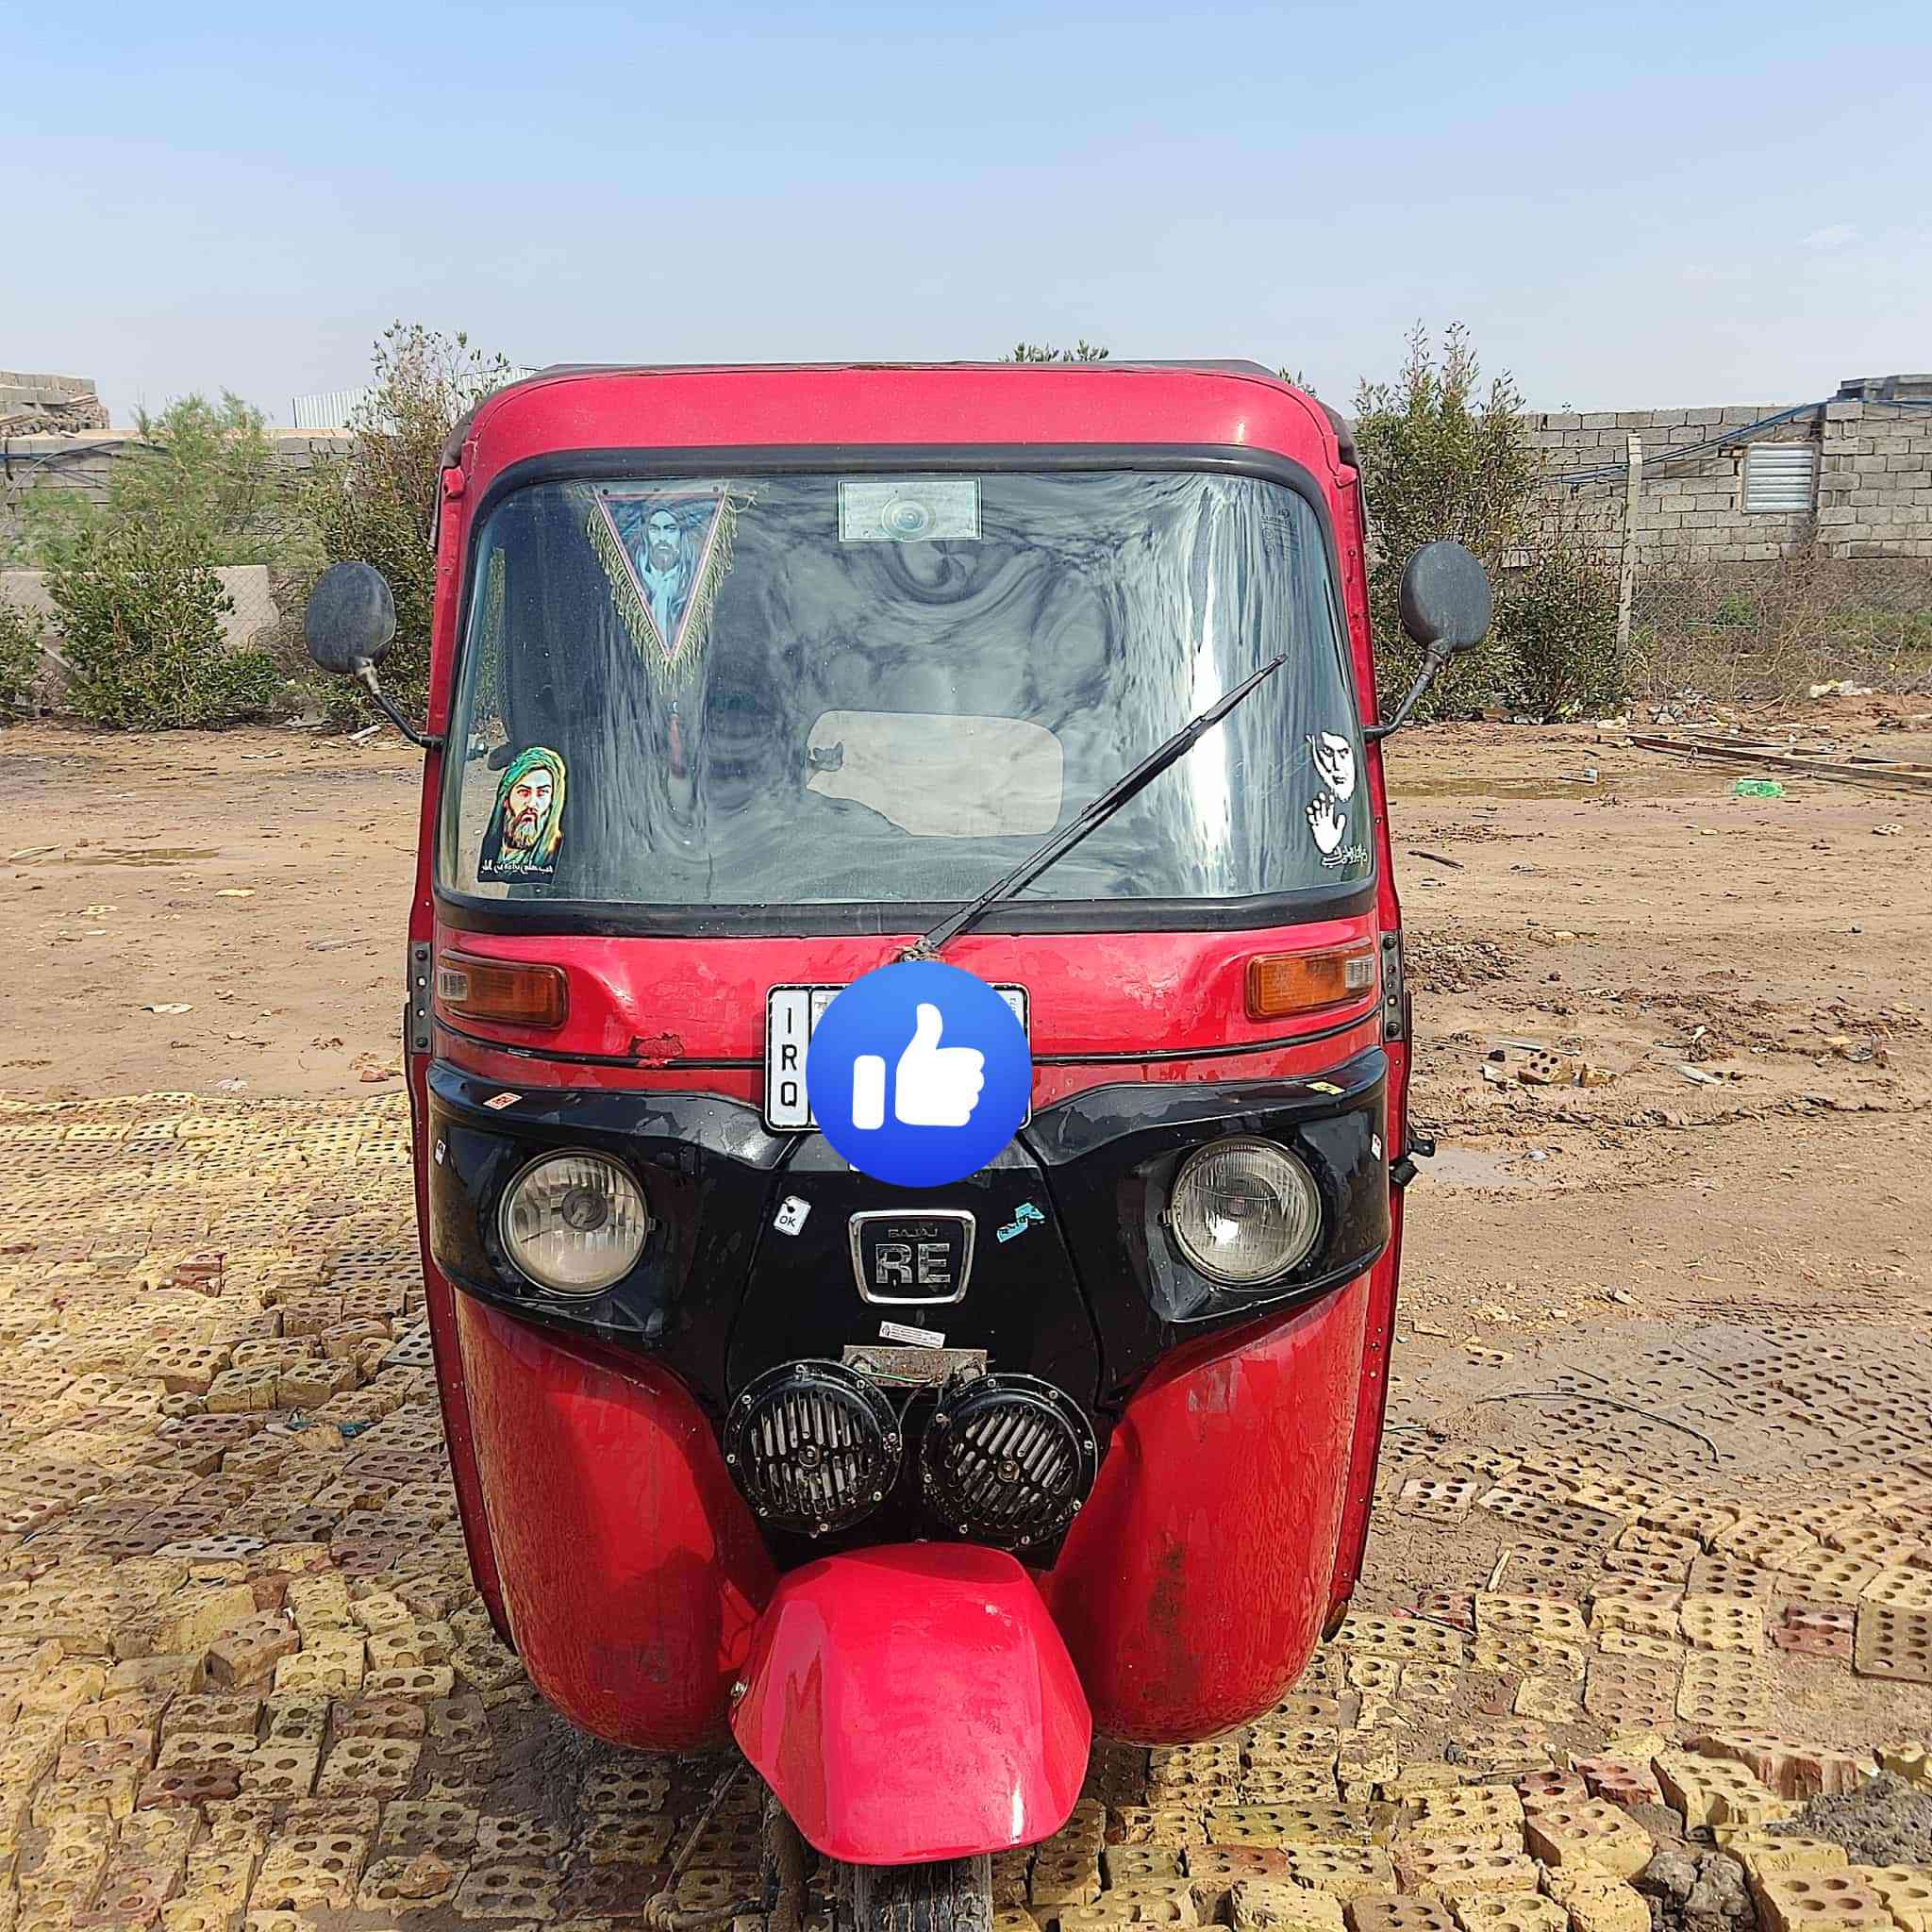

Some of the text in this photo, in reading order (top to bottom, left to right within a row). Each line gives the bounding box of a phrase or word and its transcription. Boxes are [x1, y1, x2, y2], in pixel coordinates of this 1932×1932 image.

[781, 1008, 797, 1108] IRQ
[779, 1213, 796, 1227] OK
[875, 1242, 951, 1284] RE
